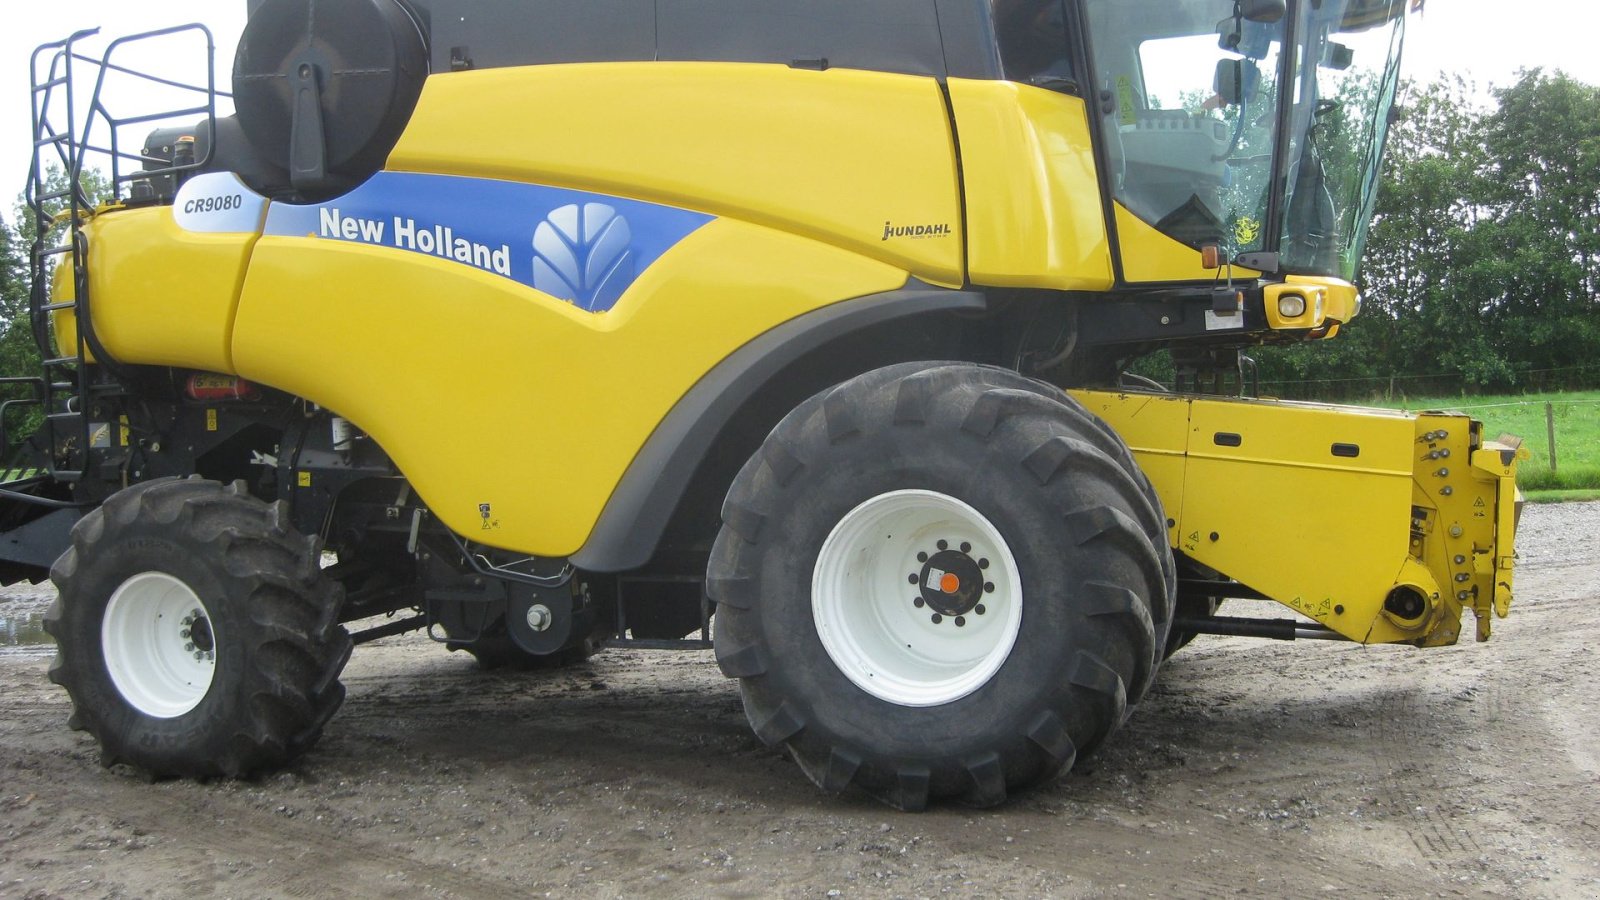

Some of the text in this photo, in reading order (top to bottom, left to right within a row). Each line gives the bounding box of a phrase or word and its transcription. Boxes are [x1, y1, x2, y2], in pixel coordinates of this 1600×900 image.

[184, 194, 242, 214] CR9080
[319, 207, 511, 277] New Holland
